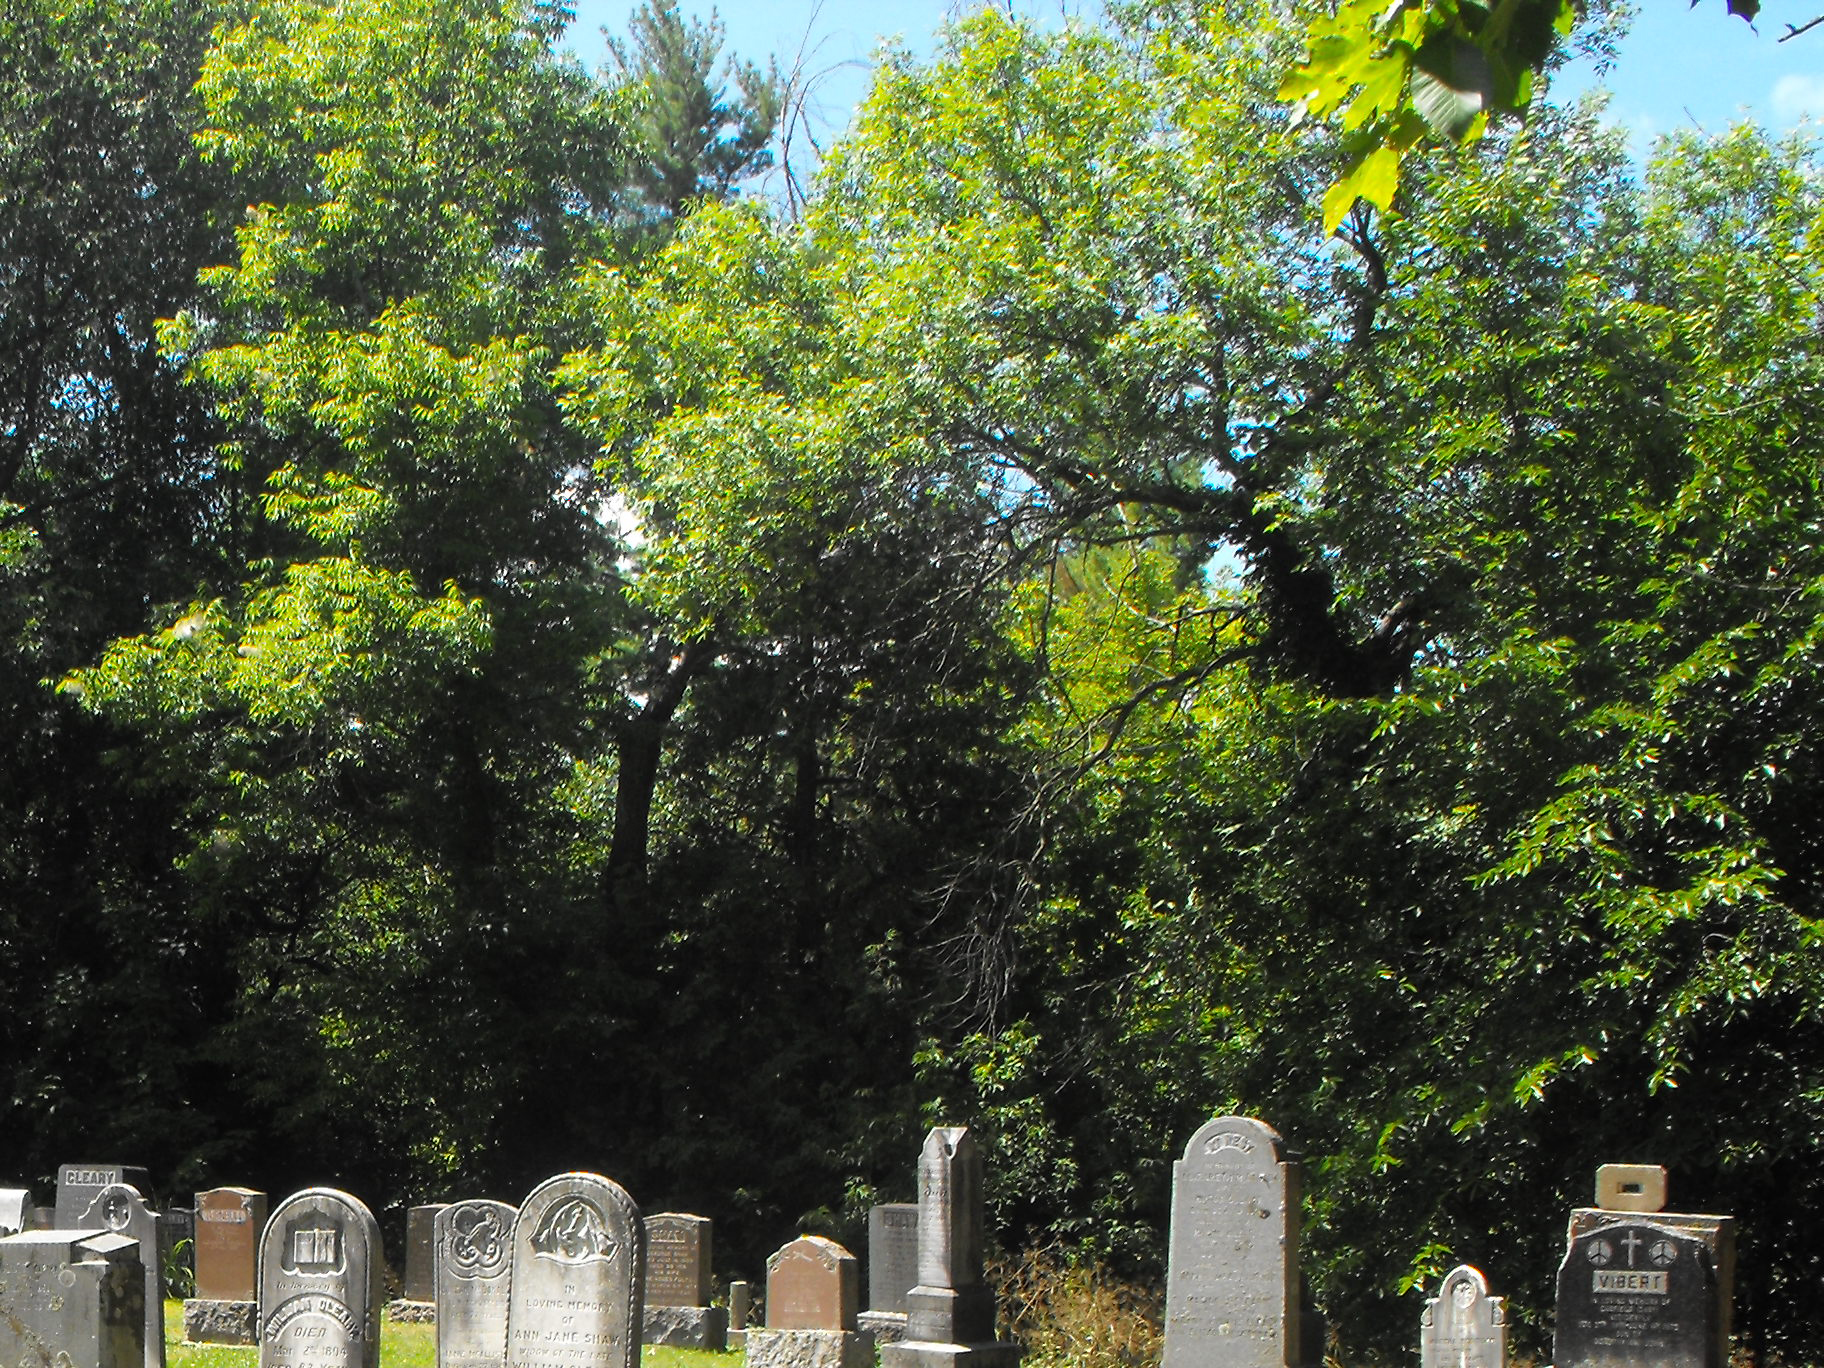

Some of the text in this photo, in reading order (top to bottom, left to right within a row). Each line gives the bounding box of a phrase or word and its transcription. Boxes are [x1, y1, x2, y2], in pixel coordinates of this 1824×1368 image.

[67, 1170, 115, 1184] CLEARY
[564, 1284, 576, 1294] IN
[1599, 1275, 1661, 1290] VIBERT
[526, 1299, 614, 1313] LOVING MEMORY
[561, 1316, 574, 1326] OF
[294, 1326, 327, 1338] DIED
[514, 1329, 540, 1341] ANN
[544, 1332, 580, 1343] JANE
[568, 1349, 585, 1359] THE
